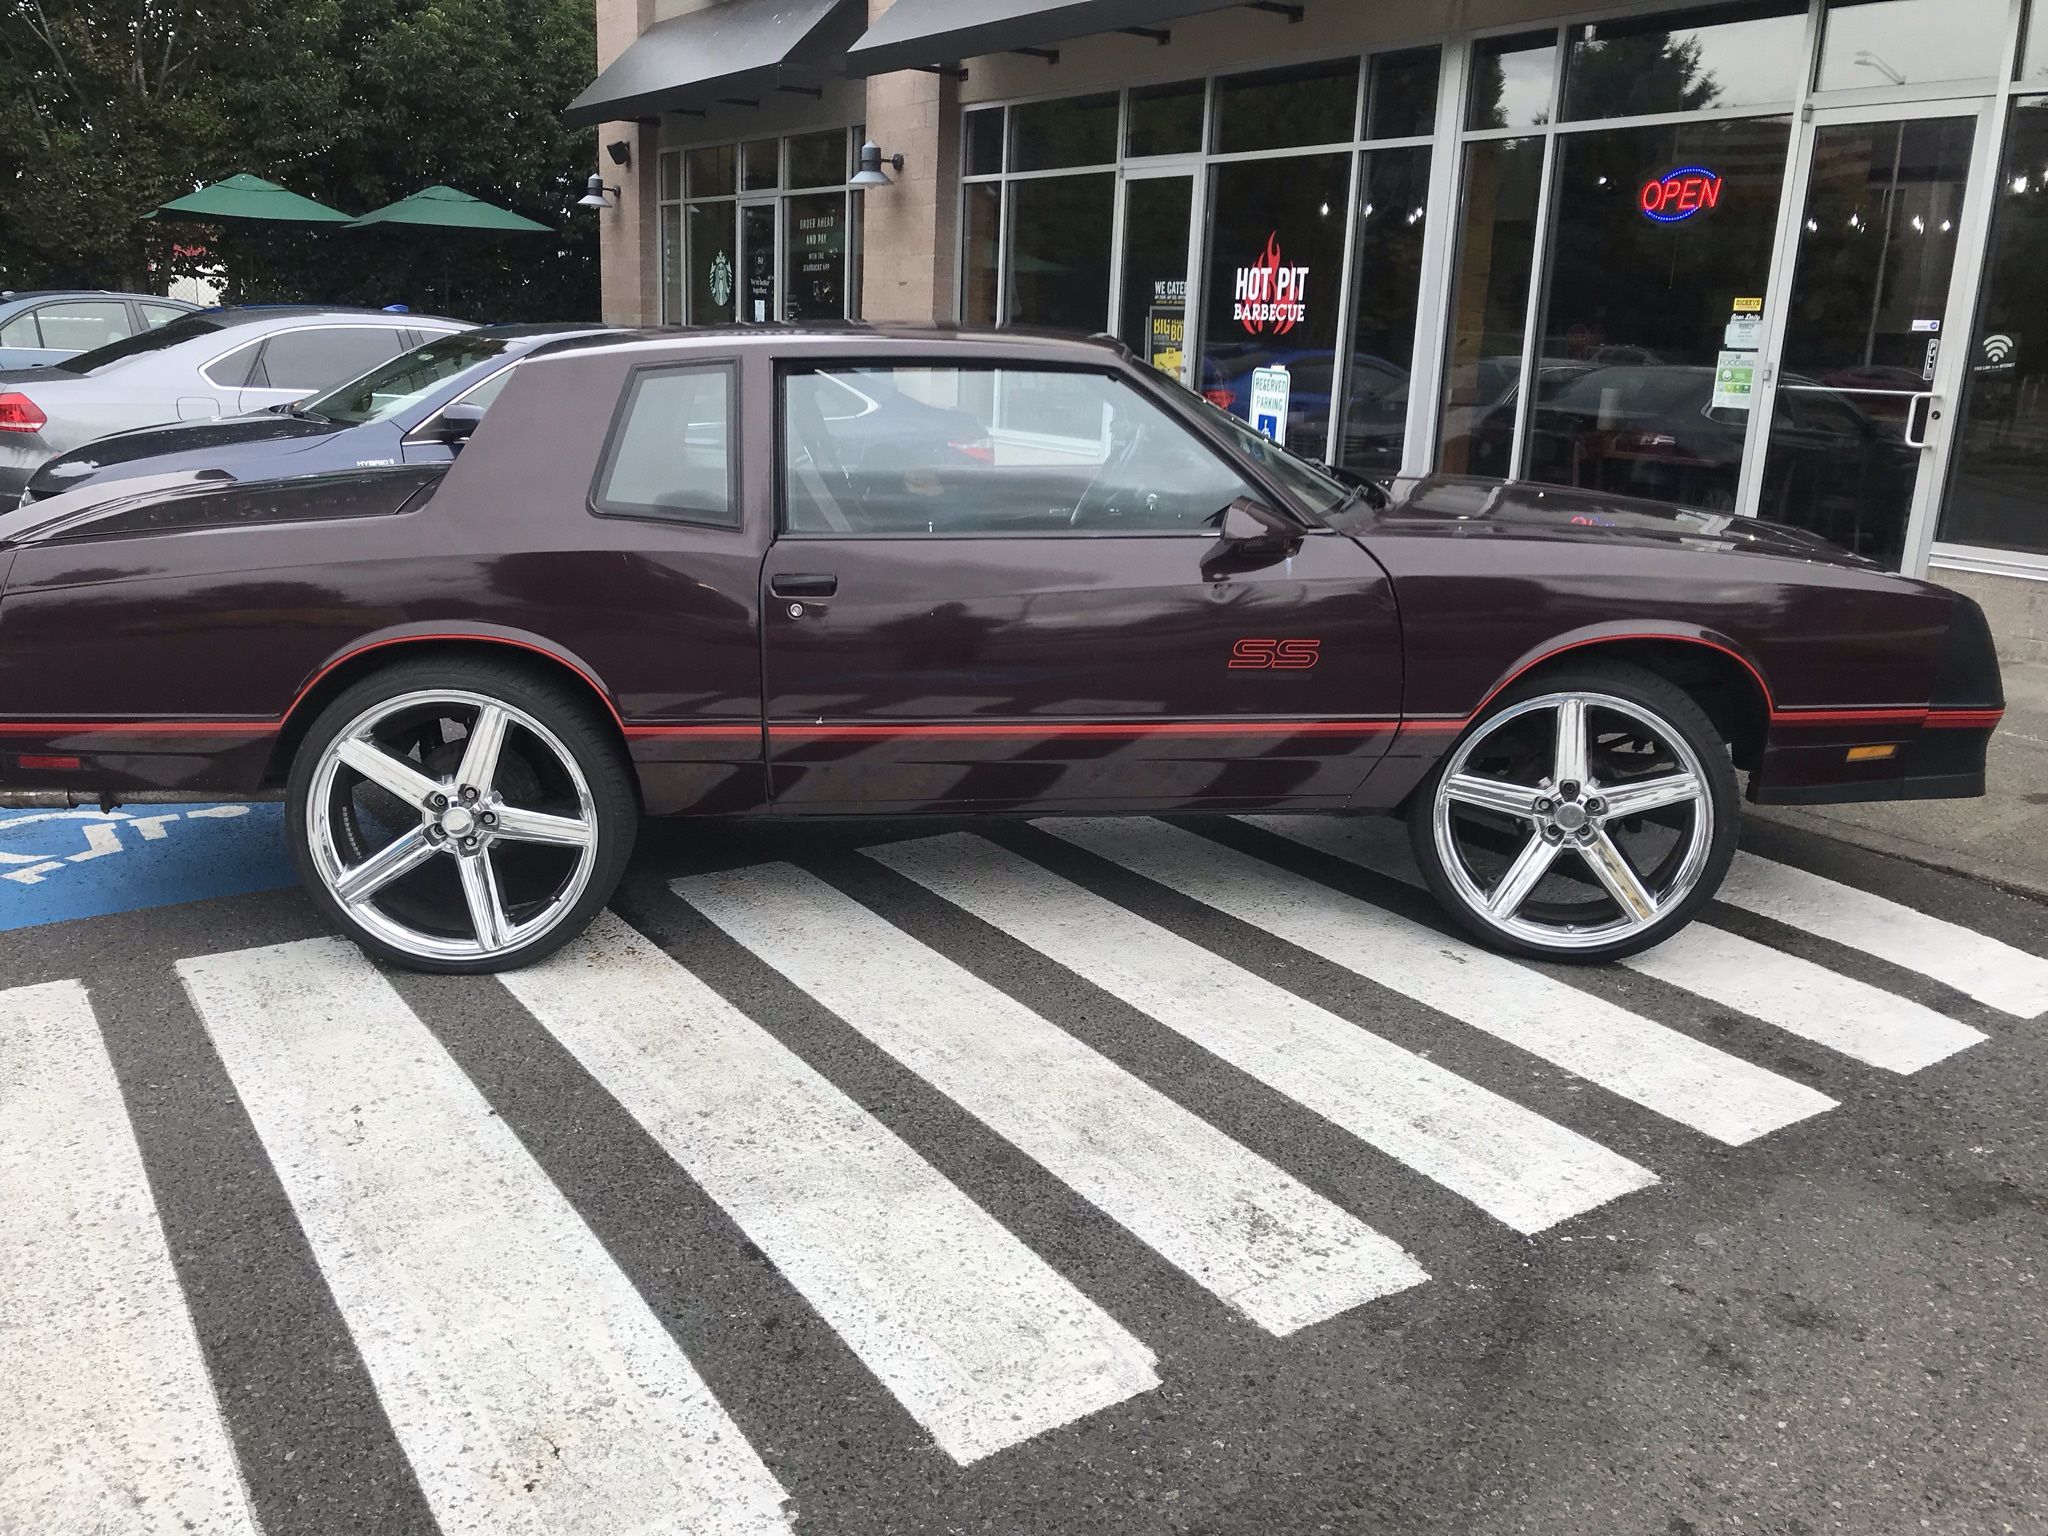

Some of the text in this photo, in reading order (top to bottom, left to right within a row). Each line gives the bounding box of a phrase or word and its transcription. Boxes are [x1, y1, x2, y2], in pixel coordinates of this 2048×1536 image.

[1642, 177, 1722, 211] OPEN
[800, 216, 834, 230] ORDER AHEAD
[806, 233, 827, 245] AND PAY
[1154, 281, 1166, 295] WE
[1235, 267, 1309, 301] HOT PIT
[1233, 303, 1306, 322] BARBECUE
[1153, 318, 1170, 335] BIG
[1170, 324, 1183, 342] BO
[1719, 359, 1741, 367] FOOD
[1927, 342, 1937, 370] PULL
[1255, 378, 1287, 393] RESERVED
[1256, 395, 1283, 412] PARKING
[1228, 639, 1321, 669] SS
